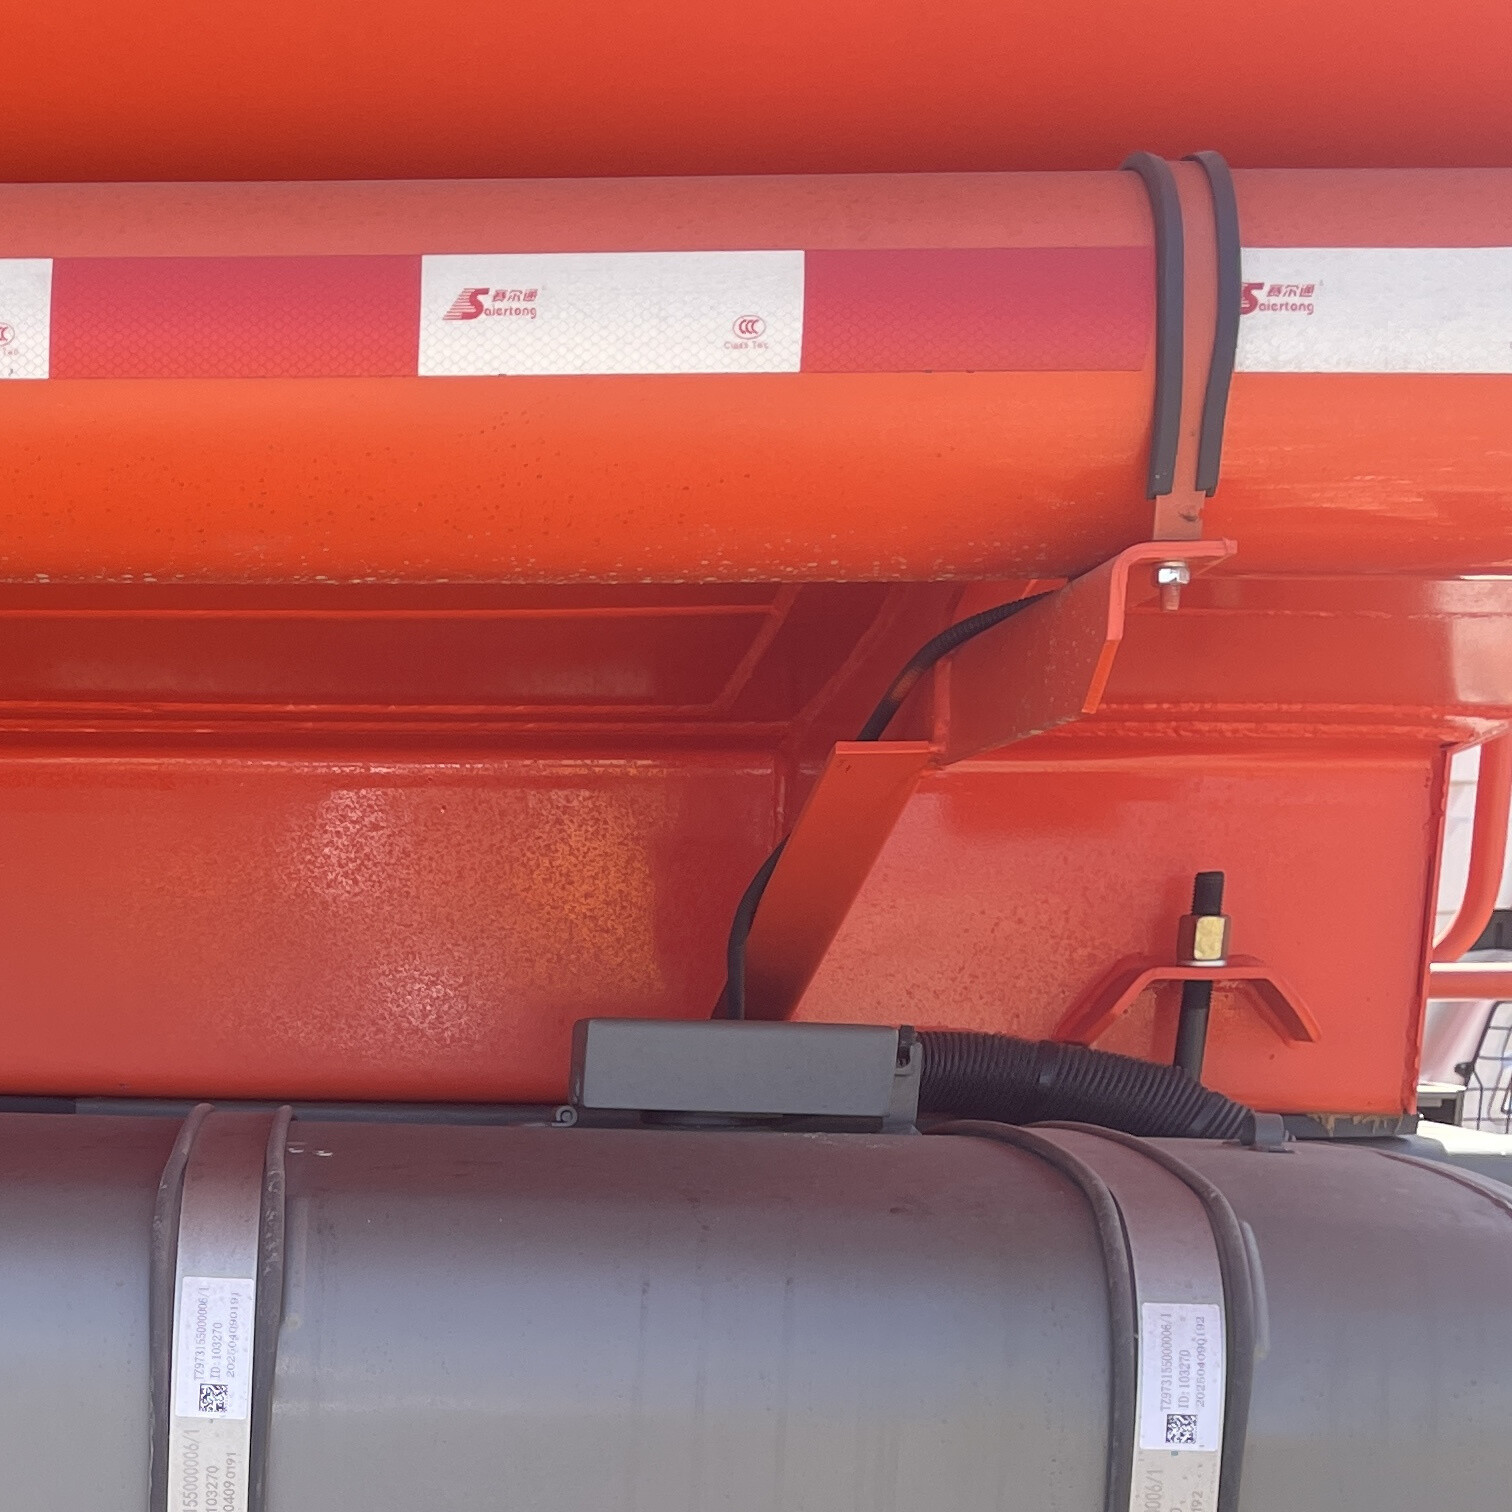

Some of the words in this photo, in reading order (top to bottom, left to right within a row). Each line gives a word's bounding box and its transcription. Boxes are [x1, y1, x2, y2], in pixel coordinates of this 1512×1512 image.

[460, 287, 537, 321] Saiertong
[1240, 282, 1315, 316] Saiertong
[193, 1287, 210, 1381] TZ973155000006/1
[210, 1322, 224, 1380] ID:103270
[1160, 1313, 1174, 1412] TZ973155000006/1
[1177, 1349, 1191, 1409] ID:103270
